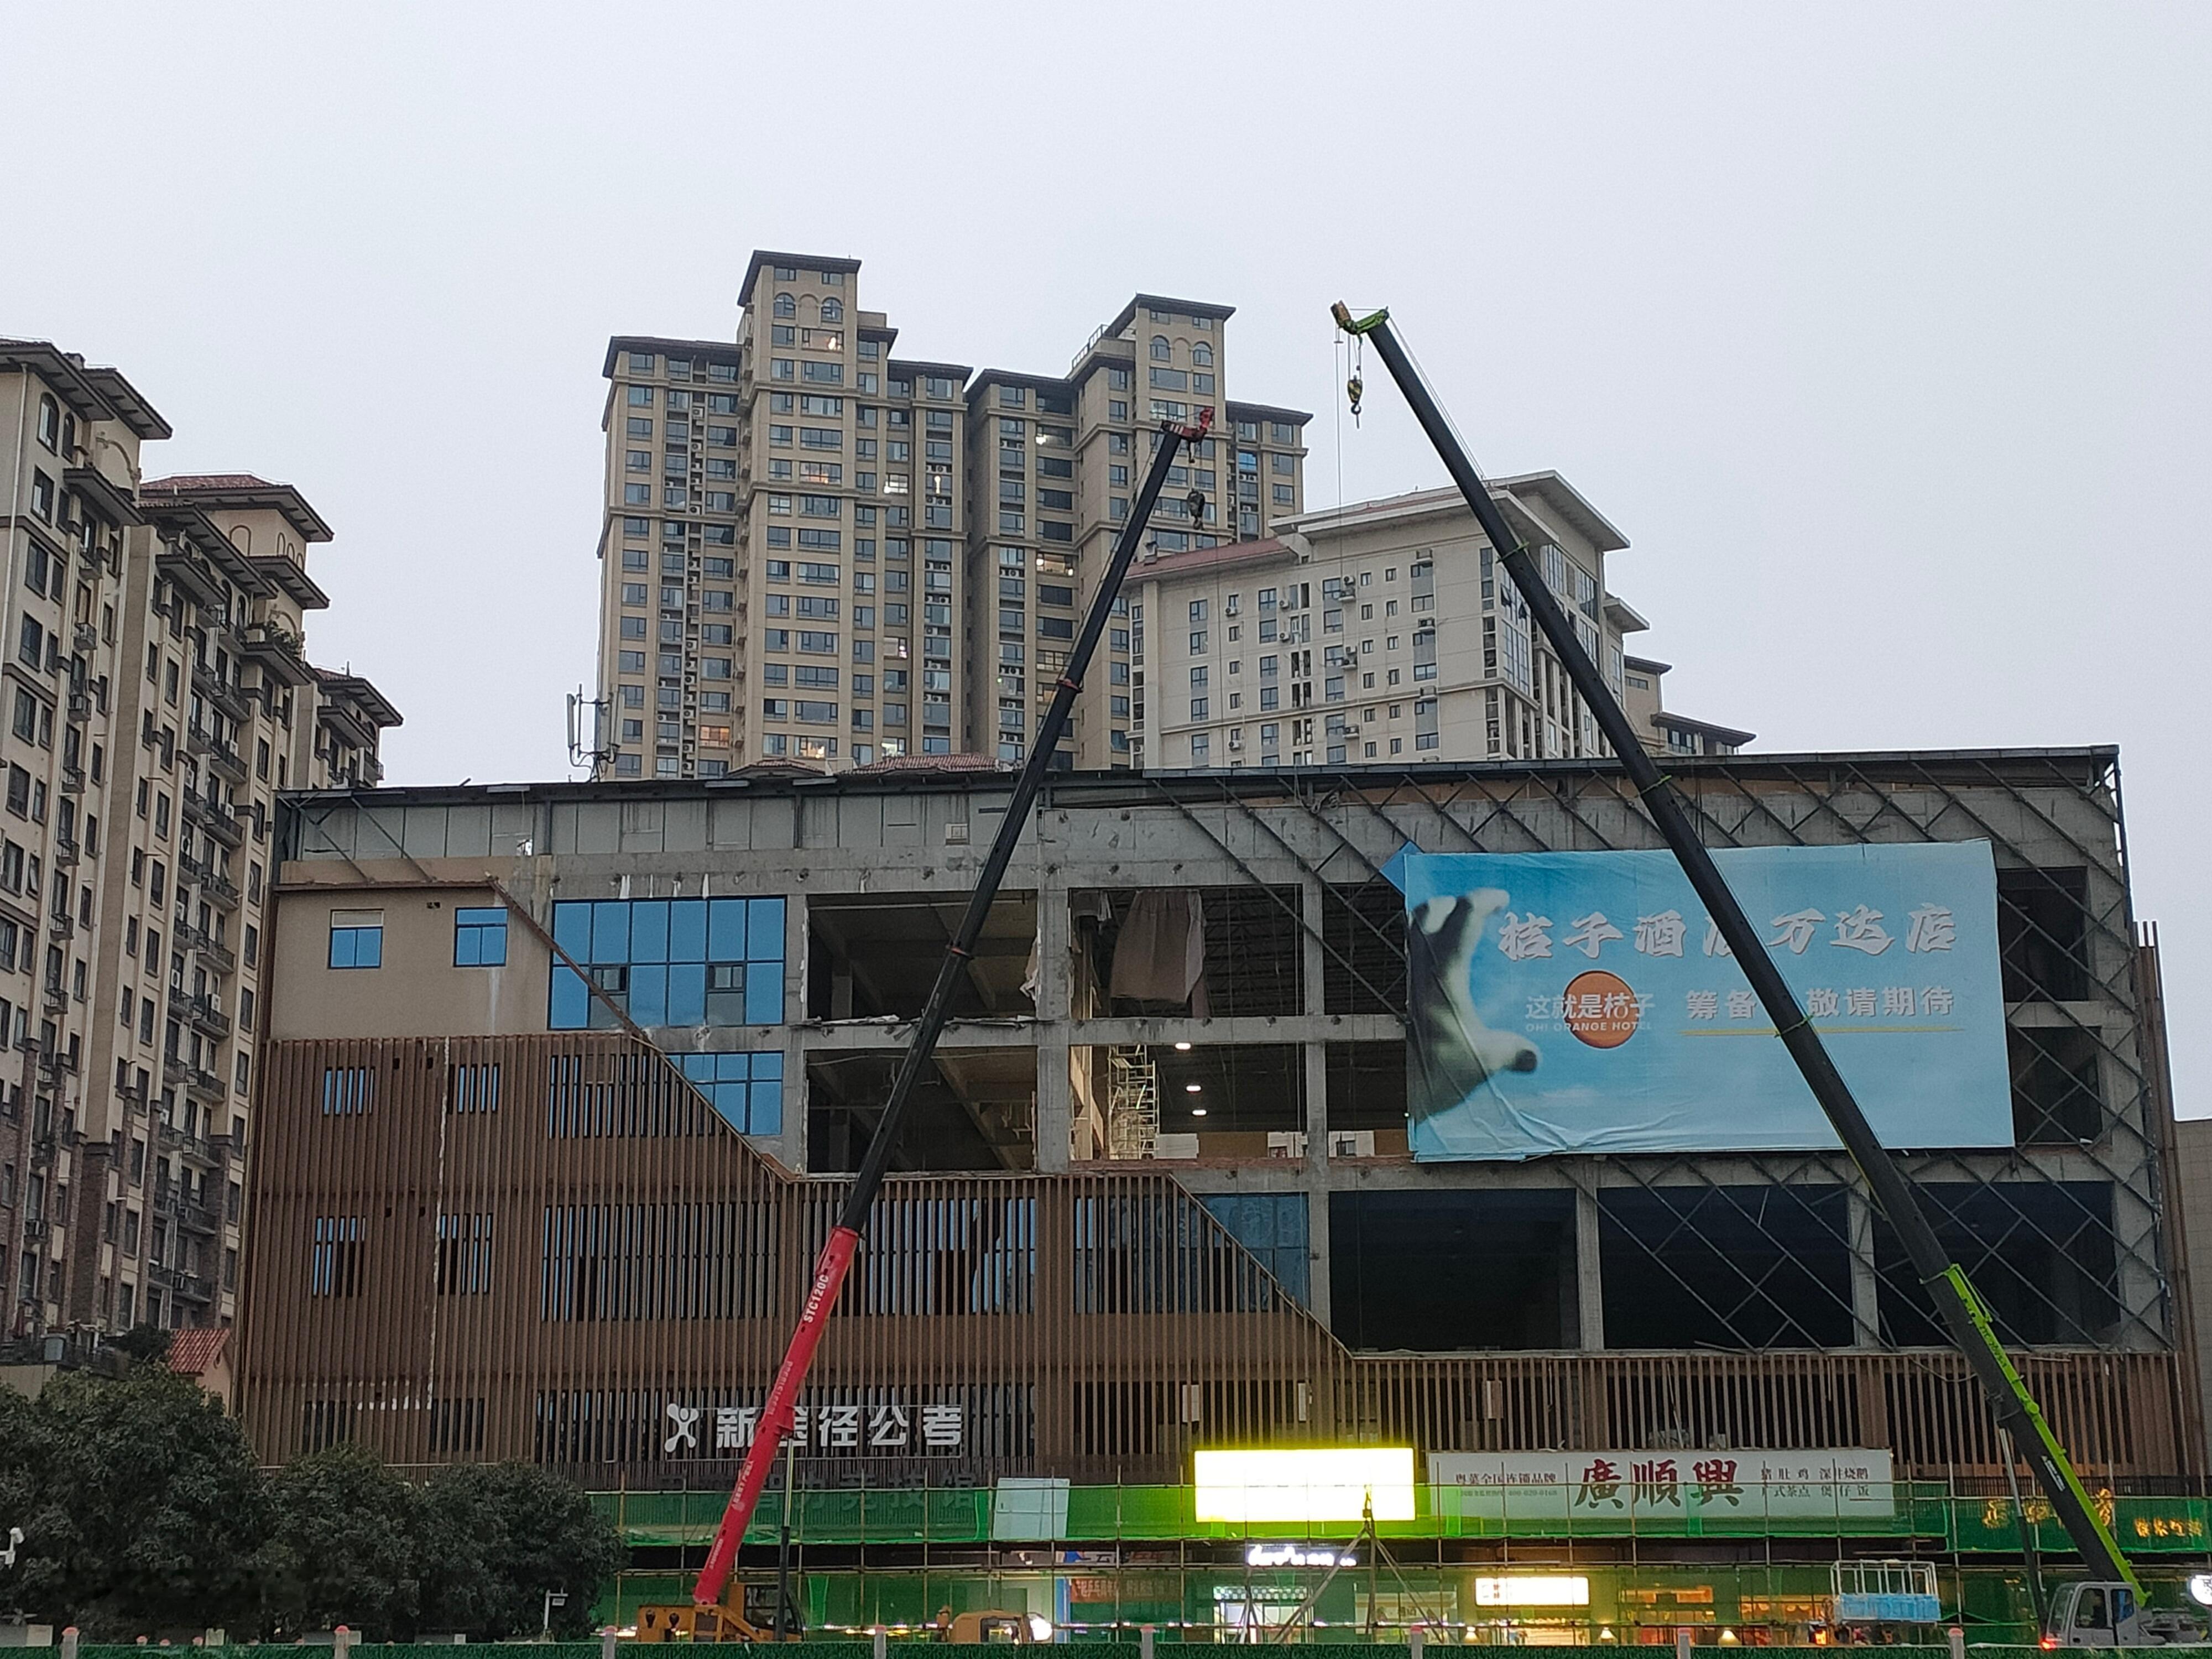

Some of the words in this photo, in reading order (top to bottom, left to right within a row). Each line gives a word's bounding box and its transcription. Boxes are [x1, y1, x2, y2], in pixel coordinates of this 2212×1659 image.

[1525, 992, 1656, 1019] 这就是桔子
[1806, 985, 1955, 1018] 敬请期待
[1553, 1021, 1608, 1031] ORANGE
[1612, 1021, 1652, 1030] HOTEL
[803, 1274, 829, 1323] STC120C
